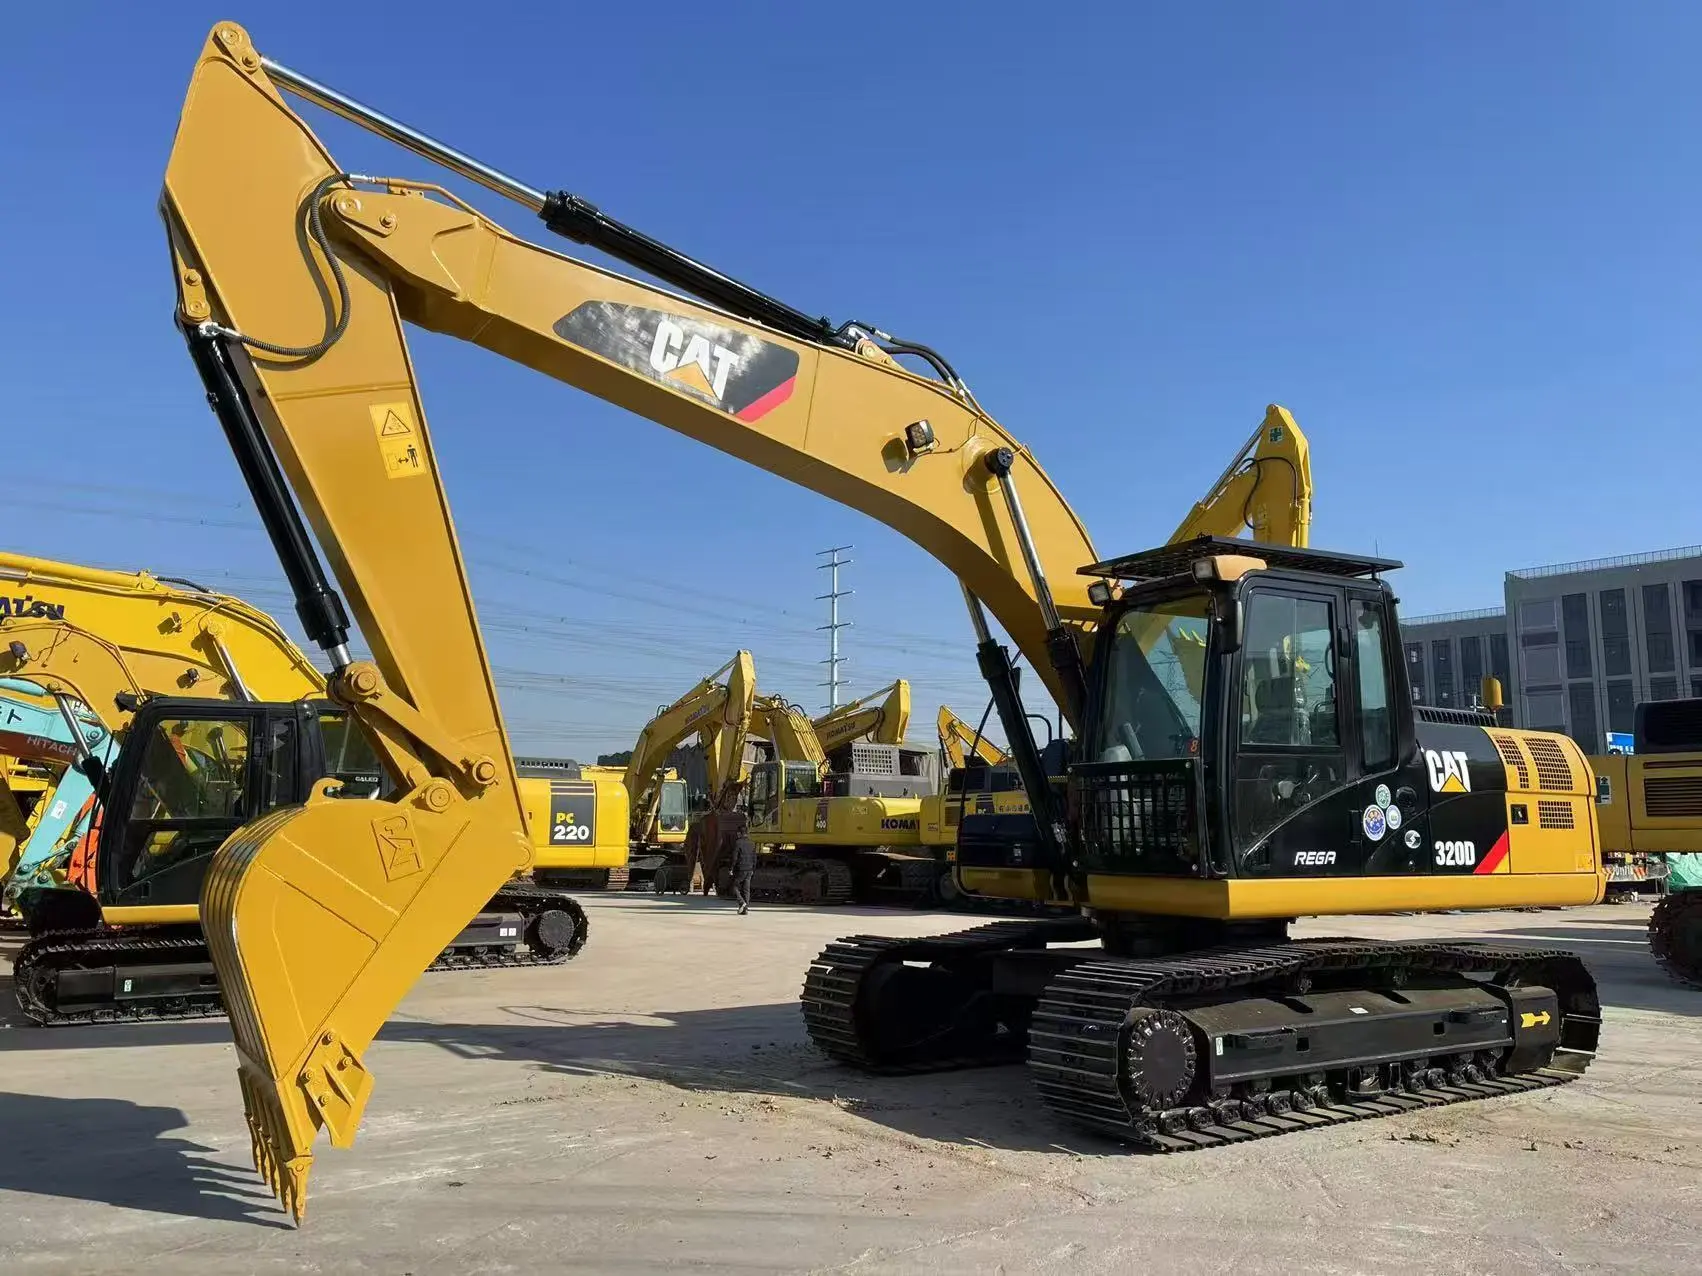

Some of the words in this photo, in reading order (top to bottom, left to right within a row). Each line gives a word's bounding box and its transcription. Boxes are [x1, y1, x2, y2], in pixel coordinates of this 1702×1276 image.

[650, 319, 739, 400] CAT
[1425, 750, 1471, 792] CAT
[556, 812, 574, 824] PC
[553, 825, 590, 840] 220
[1294, 851, 1337, 866] REGA
[1434, 841, 1476, 866] 320D
